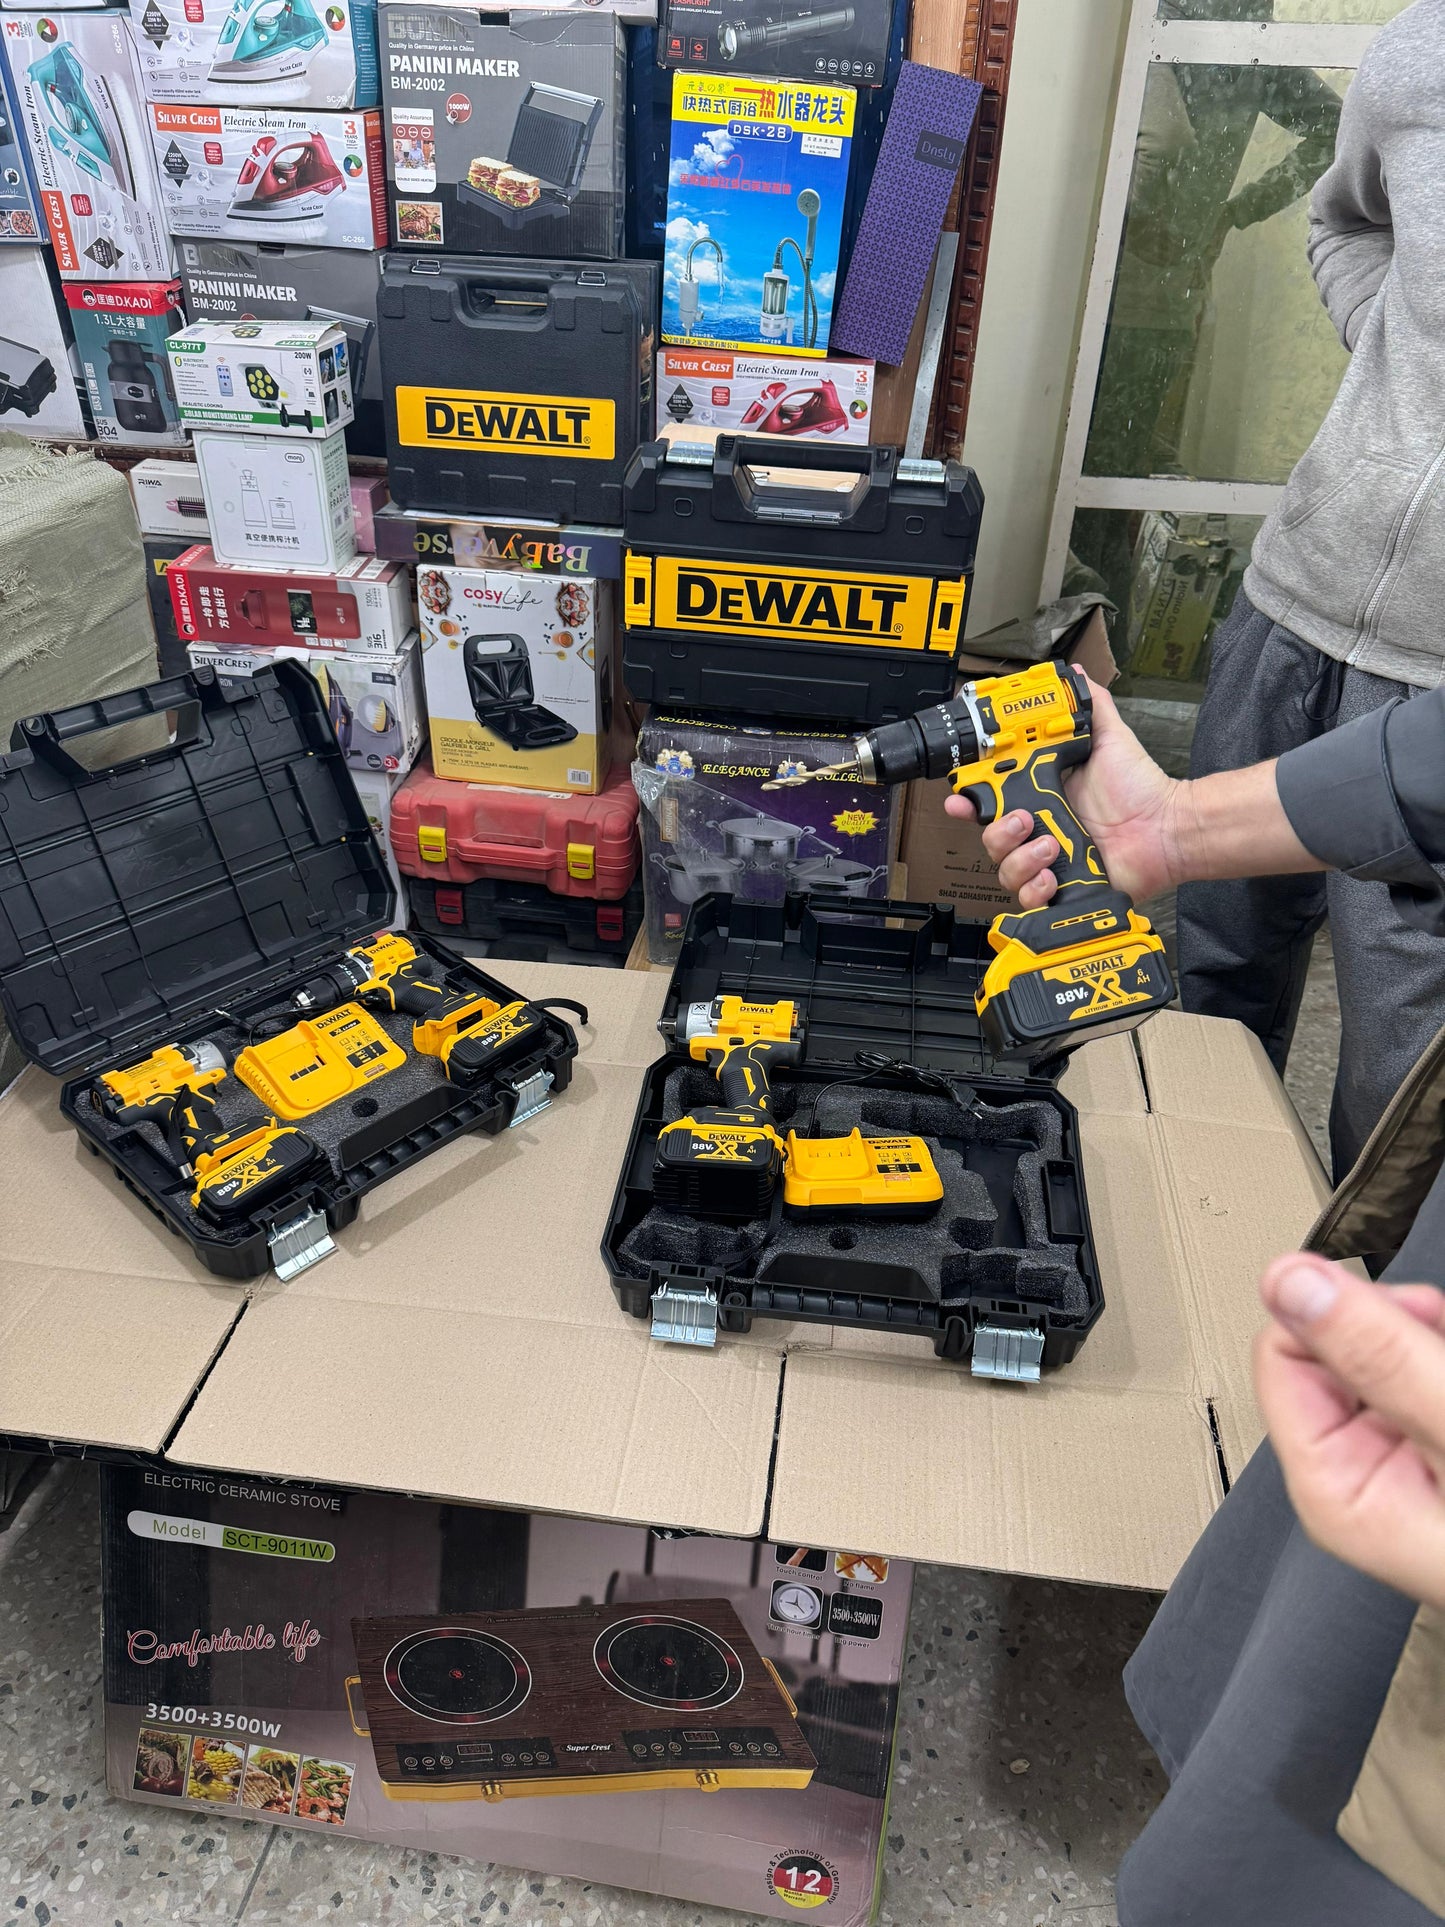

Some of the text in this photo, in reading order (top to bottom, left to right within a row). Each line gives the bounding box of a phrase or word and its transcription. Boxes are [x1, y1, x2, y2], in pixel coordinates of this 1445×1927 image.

[6, 22, 20, 37] 3
[111, 24, 124, 54] SC-266
[389, 42, 407, 50] Quality
[414, 43, 437, 52] Germany
[280, 61, 303, 73] SILVER CREST
[389, 55, 520, 78] PANINI MAKER
[391, 76, 446, 91] BM-2002
[94, 79, 110, 109] SILVER CREST
[682, 89, 846, 125] 快热式厨浴 热水器龙头
[157, 111, 218, 126] SILVER CREST
[224, 115, 307, 129] Electric Steam Iron
[343, 120, 357, 134] 3
[733, 124, 786, 139] DSK-28
[22, 85, 53, 188] Electric Steam Iron
[48, 193, 73, 268] SILVER CREST
[342, 236, 366, 244] SC-266
[188, 279, 298, 302] PANINI MAKER
[192, 297, 237, 312] BM-2002
[94, 314, 146, 329] 1.3L大容量
[169, 341, 201, 350] CL-977T
[667, 359, 731, 373] SILVER CREST
[736, 364, 819, 377] Electric Steam Iron
[856, 370, 868, 383] 3
[184, 409, 254, 421] SOLAR MONITORING LAMP
[98, 426, 118, 436] 304
[137, 478, 163, 486] RIWA
[245, 533, 300, 545] 真空便携榨汁机
[198, 586, 214, 628] 一拎即走
[213, 587, 230, 629] 方便出行
[372, 634, 383, 649] 316
[702, 764, 771, 778] ELEGANCE
[665, 803, 674, 840] ORIGINAL
[939, 889, 1011, 903] SHAD ADHASIVE TAPE
[1137, 974, 1151, 984] AH
[1084, 1005, 1108, 1014] LITHIUM
[144, 1472, 341, 1512] ELECTRIC CERAMIC STOVE
[152, 1518, 327, 1558] Model SCT-9011W
[775, 1566, 823, 1581] Touch control
[855, 1582, 875, 1591] flame
[832, 1607, 880, 1627] 3500+3500W
[786, 1627, 801, 1636] hour
[126, 1618, 321, 1667] Comfortable life
[848, 1639, 870, 1648] power
[145, 1702, 282, 1739] 3500+3500W
[566, 1743, 613, 1752] Super Crest
[774, 1848, 825, 1862] Technology
[825, 1861, 835, 1869] of
[765, 1868, 776, 1896] Design
[786, 1866, 822, 1892] 12
[826, 1870, 840, 1905] Germany
[783, 1893, 807, 1902] Warranty
